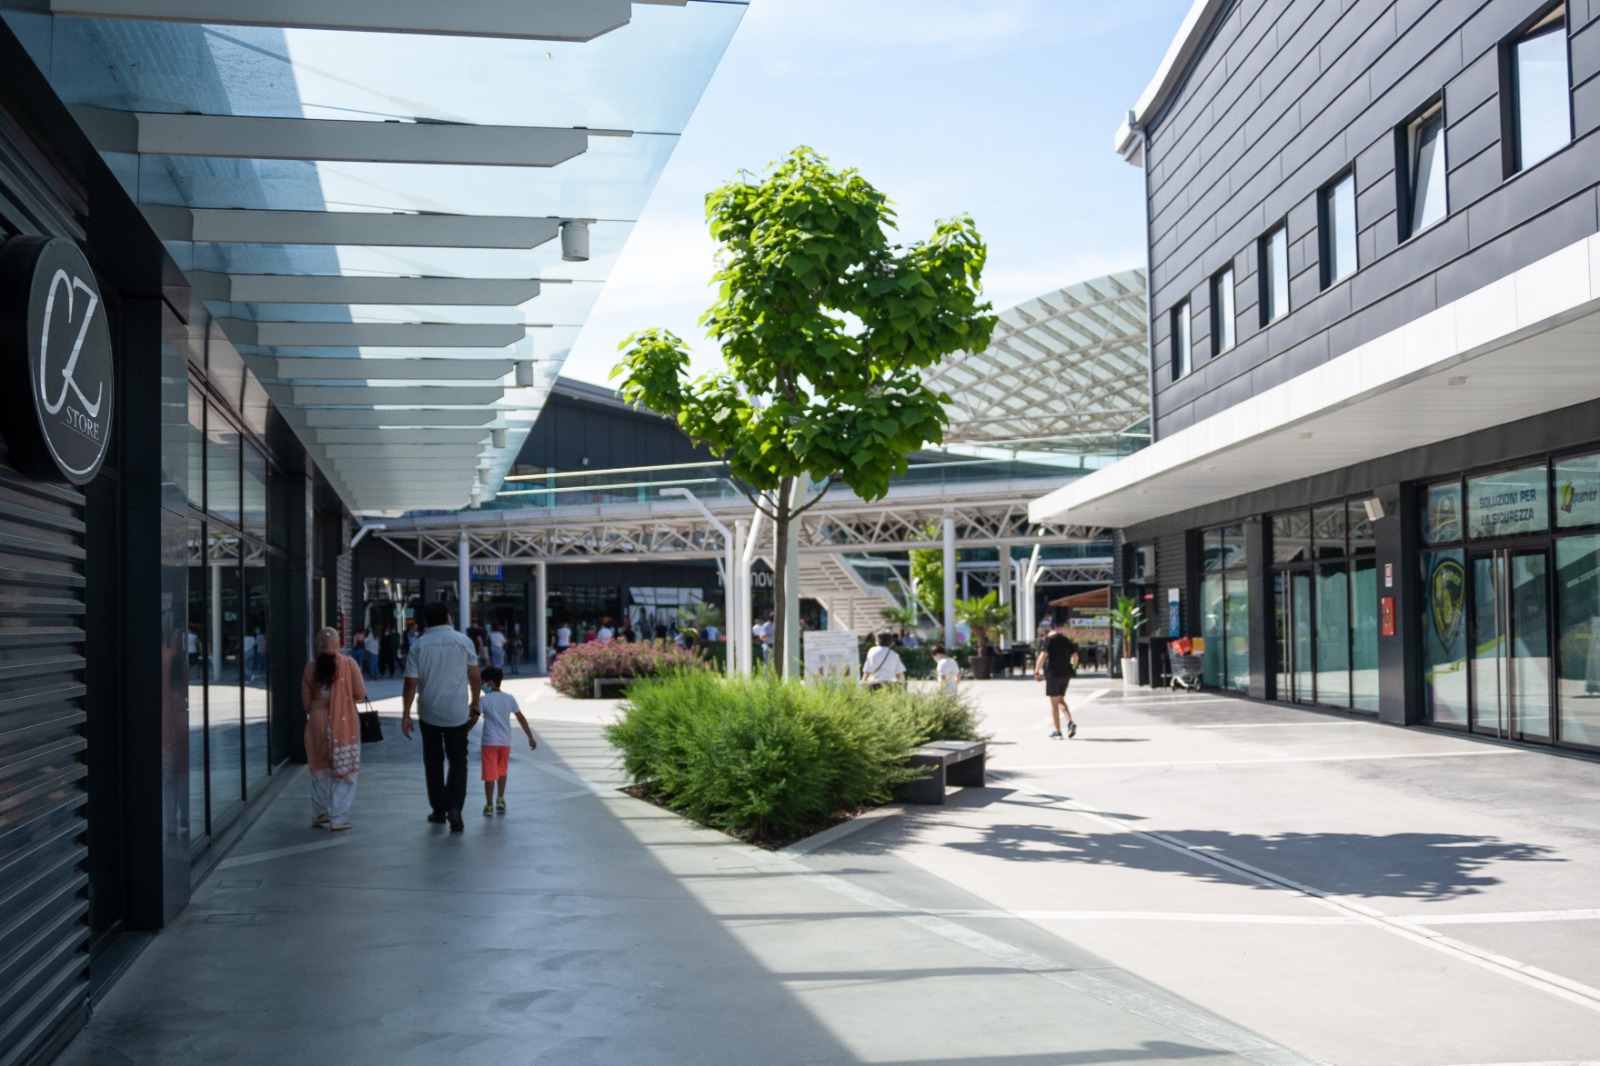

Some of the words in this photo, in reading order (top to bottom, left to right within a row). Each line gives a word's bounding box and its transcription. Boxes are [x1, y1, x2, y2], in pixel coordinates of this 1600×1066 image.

[66, 405, 100, 441] STORE
[1479, 491, 1518, 509] SOLUZIONI
[1520, 488, 1537, 503] PER
[1481, 514, 1491, 526] LA
[1492, 507, 1535, 526] SICUREZZA
[472, 564, 499, 577] KIABI
